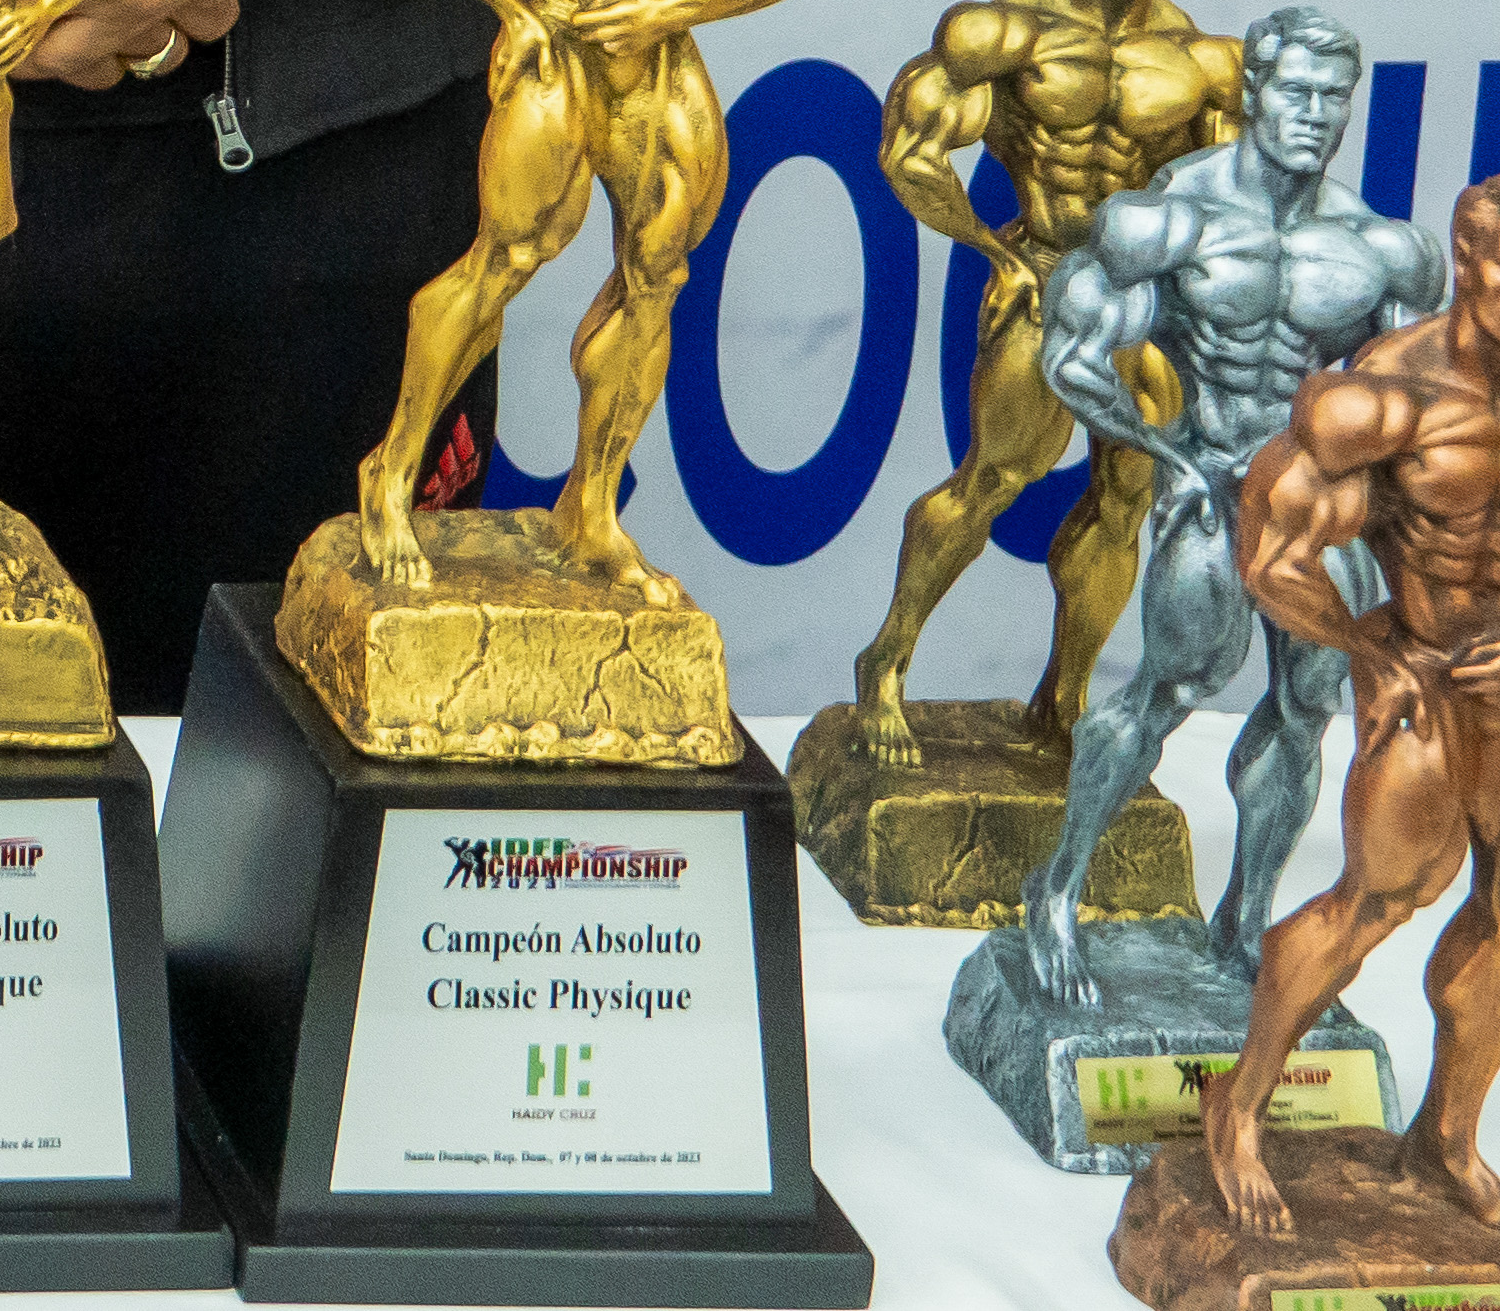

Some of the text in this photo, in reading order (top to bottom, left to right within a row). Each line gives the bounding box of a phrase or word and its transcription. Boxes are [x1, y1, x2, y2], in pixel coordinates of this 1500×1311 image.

[487, 854, 687, 880] CHAMPIONSHIP
[421, 921, 701, 961] Campeón Absoluto
[427, 978, 692, 1018] Classic Physique
[512, 1108, 555, 1120] HAIDY
